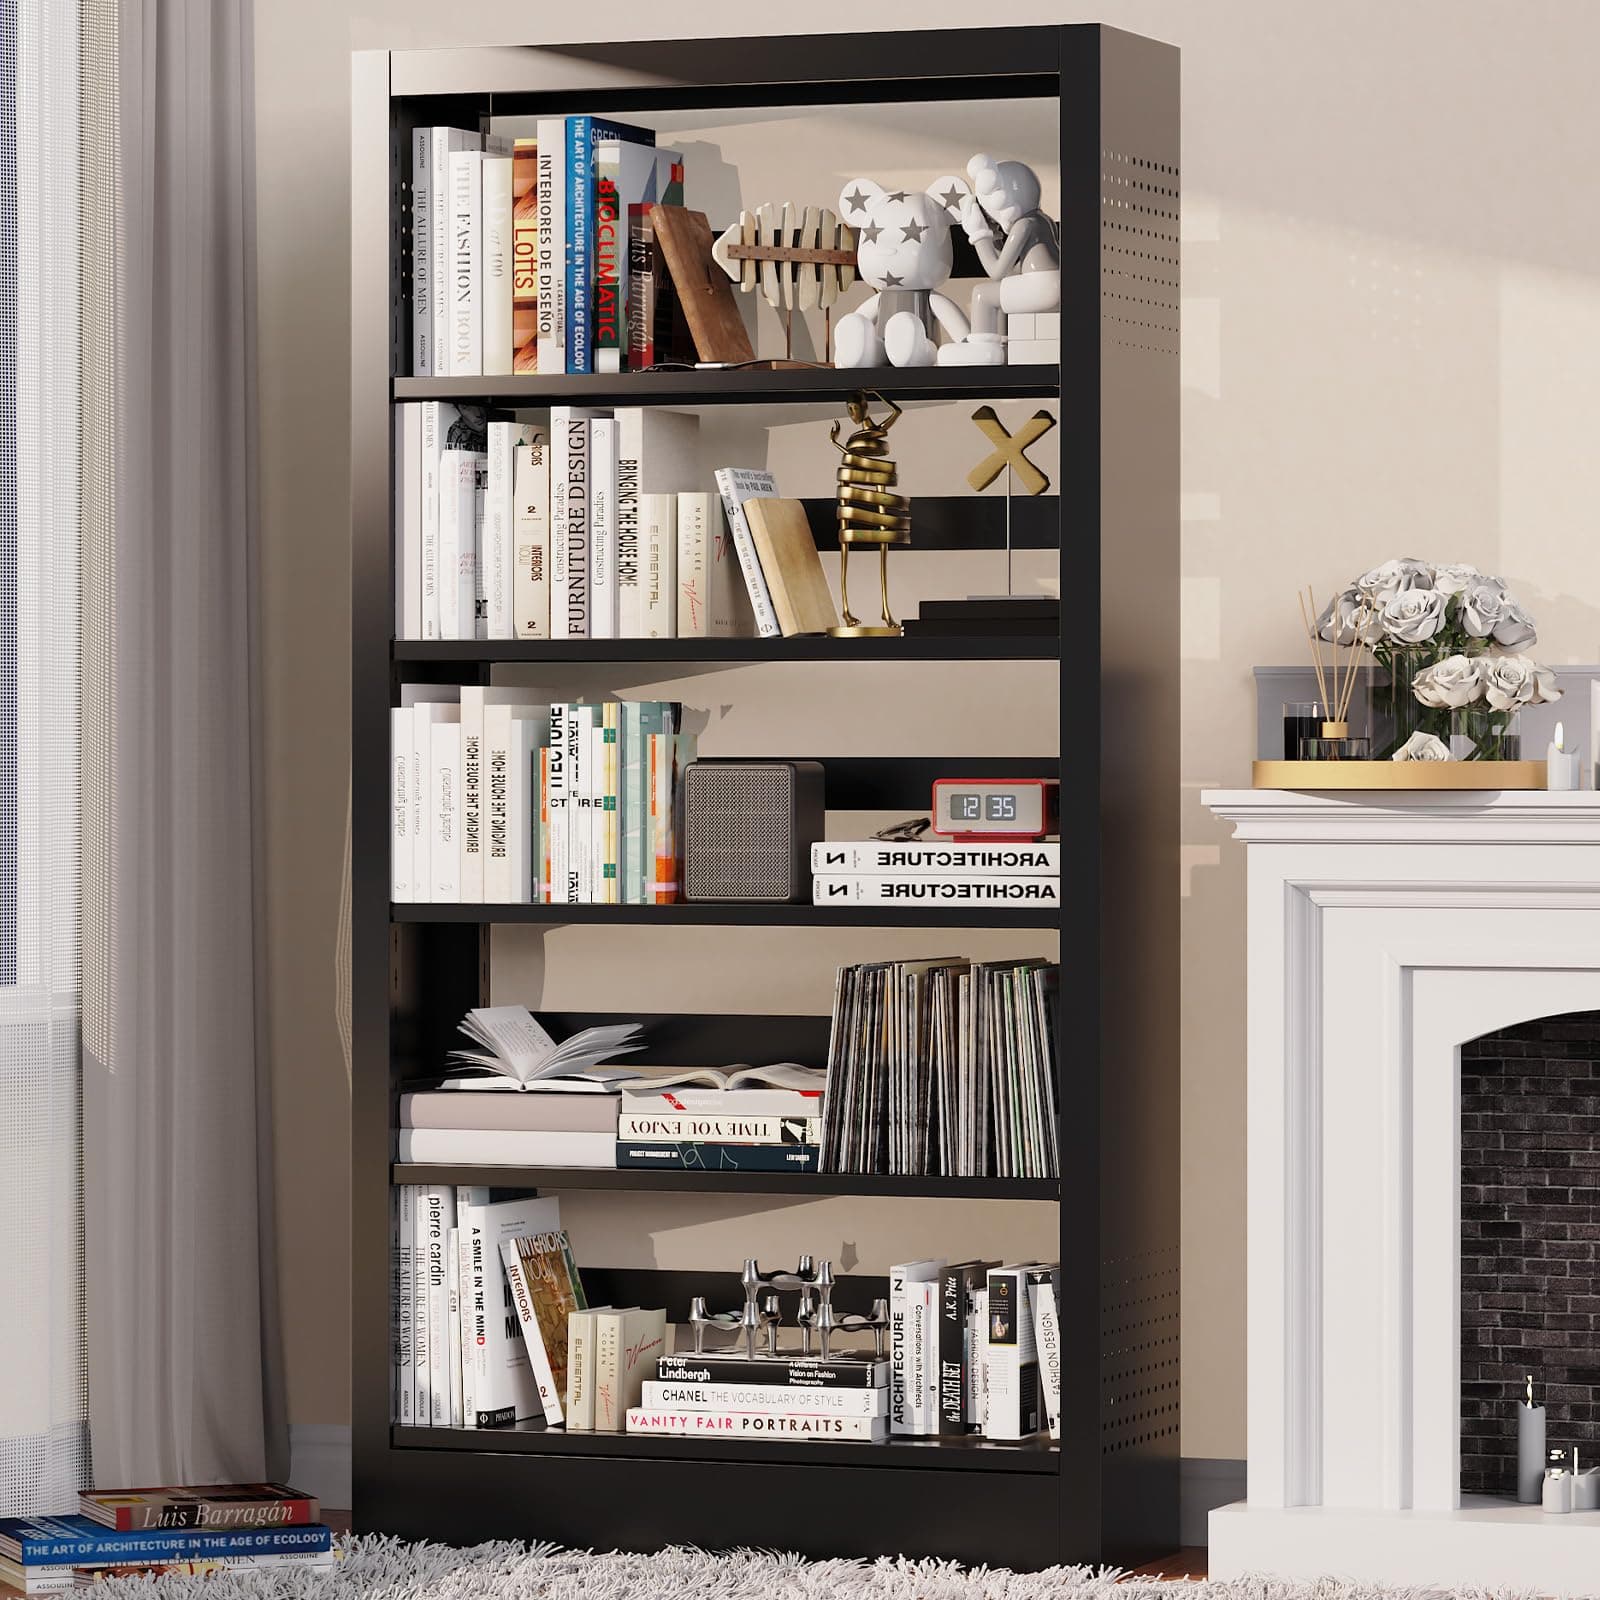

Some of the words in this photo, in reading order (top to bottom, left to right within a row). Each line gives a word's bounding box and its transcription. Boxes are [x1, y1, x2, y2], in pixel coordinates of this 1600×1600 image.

[575, 118, 585, 138] THE
[575, 140, 585, 159] ART
[575, 161, 585, 175] OF
[417, 186, 427, 213] THE
[540, 154, 552, 245] INTERIORES
[575, 177, 585, 252] ARCHITECTURE
[417, 215, 427, 265] ALLURE
[630, 225, 655, 263] Luis
[457, 214, 471, 303] FASHION
[540, 249, 552, 270] DE
[575, 254, 585, 265] IN
[598, 180, 617, 342] BIOCLIMATIC
[417, 267, 427, 284] OF
[575, 267, 585, 286] THE
[417, 287, 427, 315] MEN
[540, 275, 554, 333] DISEÑO
[575, 289, 585, 308] AGE
[628, 269, 654, 353] Barragán
[575, 310, 585, 324] OF
[457, 310, 471, 363] BOOK
[575, 326, 585, 371] ECOLOGY
[568, 420, 585, 500] DESIGN
[618, 459, 638, 504] BRINGING
[526, 505, 537, 514] 2
[618, 507, 638, 525] THE
[694, 507, 702, 545] NADIA
[618, 528, 638, 558] HOUSE
[531, 544, 543, 581] INTERIORS
[568, 508, 585, 635] FURNITURE
[618, 561, 638, 587] HOME
[649, 525, 659, 610] ELEMENTAL
[694, 552, 702, 572] LEE
[526, 621, 537, 629] 2
[963, 796, 978, 817] 12
[991, 796, 1014, 817] 35
[627, 1119, 681, 1135] ENJOY
[687, 1120, 722, 1136] YOU
[727, 1121, 771, 1136] TIME
[428, 1197, 445, 1239] pierre
[472, 1227, 481, 1236] A
[401, 1246, 411, 1267] THE
[416, 1246, 426, 1267] THE
[473, 1239, 483, 1272] SMILE
[515, 1231, 569, 1258] INTERIORS
[430, 1243, 446, 1286] cardin
[401, 1269, 411, 1309] ALLURE
[416, 1269, 426, 1309] ALLURE
[474, 1276, 484, 1288] IN
[509, 1264, 532, 1323] INTERIORS
[945, 1276, 957, 1299] Price
[475, 1291, 484, 1312] THE
[401, 1311, 411, 1325] OF
[416, 1311, 426, 1325] OF
[476, 1315, 486, 1346] MIND
[915, 1305, 924, 1355] Conversations
[1041, 1312, 1057, 1349] DESIGN
[401, 1326, 411, 1367] WOMEN
[416, 1326, 426, 1368] WOMEN
[971, 1328, 979, 1365] FASHION
[574, 1338, 583, 1406] ELEMENTAL
[660, 1367, 711, 1382] Lindbergh
[789, 1369, 807, 1379] Vision
[807, 1370, 814, 1378] on
[815, 1370, 837, 1380] Fashion
[893, 1312, 904, 1425] ARCHITECTURE
[915, 1357, 924, 1372] with
[942, 1359, 961, 1379] BET
[540, 1386, 548, 1399] 2
[789, 1378, 825, 1387] Photography
[915, 1373, 924, 1409] Architects
[942, 1379, 961, 1411] DEATH
[971, 1367, 979, 1400] DESIGN
[662, 1389, 708, 1402] CHANEL
[711, 1391, 729, 1403] THE
[732, 1392, 797, 1405] VOCABULARY
[799, 1394, 813, 1406] OF
[814, 1395, 844, 1407] STYLE
[631, 1415, 688, 1428] VANITY
[696, 1416, 734, 1430] FAIR
[742, 1418, 843, 1432] PORTRAITS
[946, 1411, 961, 1424] the
[143, 1505, 188, 1528] Luis
[194, 1500, 294, 1526] Barragán
[26, 1545, 49, 1556] THE
[52, 1543, 75, 1555] ART
[78, 1542, 94, 1554] OF
[96, 1539, 185, 1553] ARCHITECTURE
[189, 1538, 202, 1549] IN
[204, 1537, 227, 1548] THE
[229, 1536, 252, 1547] AGE
[255, 1535, 271, 1546] OF
[274, 1532, 326, 1545] ECOLOGY
[279, 1552, 319, 1561] ASSOULINE
